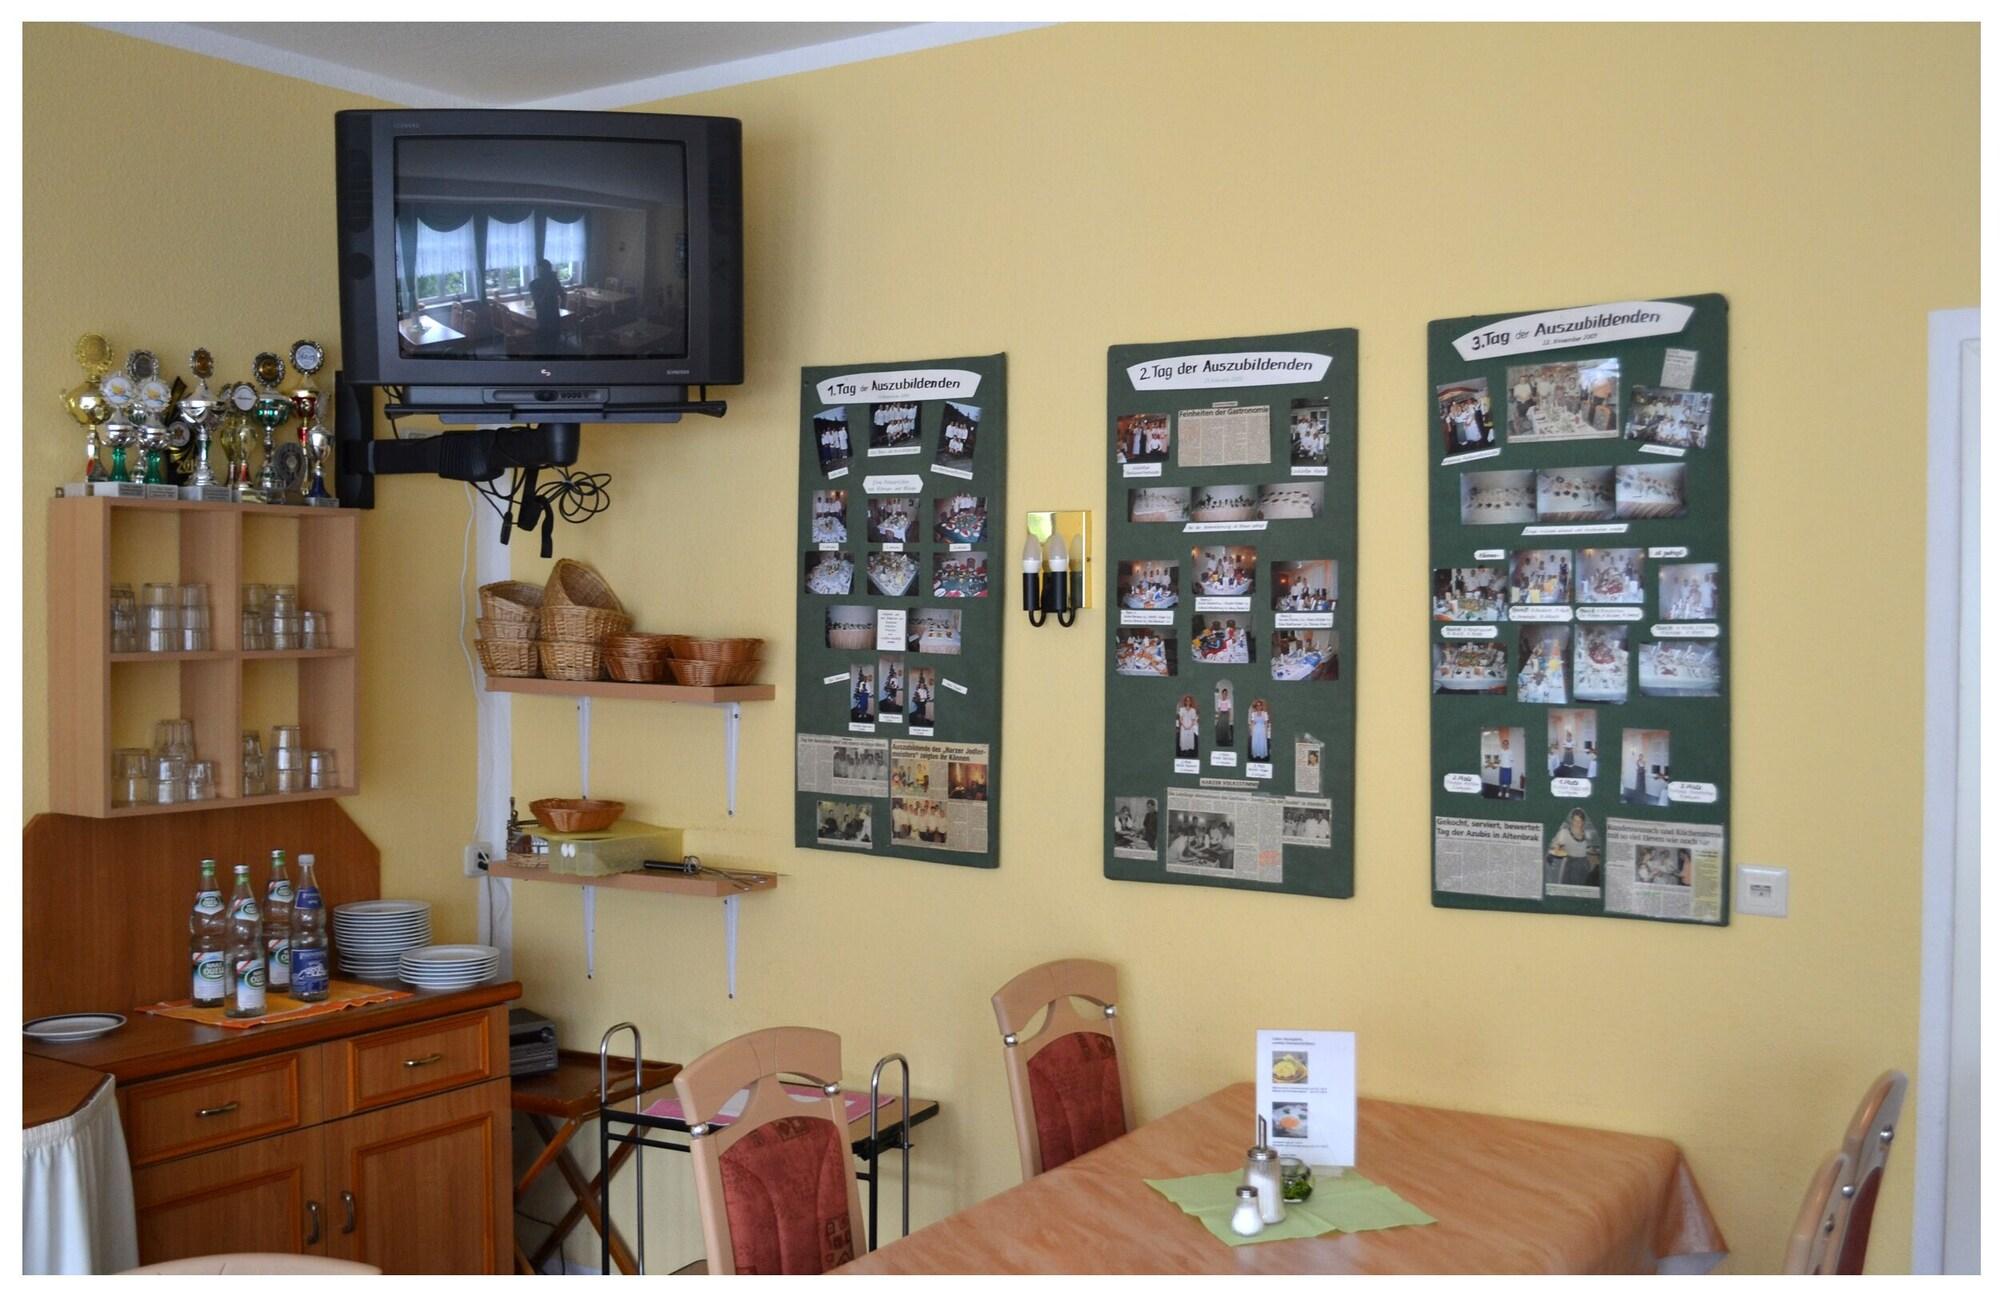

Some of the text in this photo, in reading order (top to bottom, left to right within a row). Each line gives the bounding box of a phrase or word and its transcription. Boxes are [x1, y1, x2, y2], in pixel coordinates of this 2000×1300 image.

[1515, 329, 1530, 341] der
[1534, 309, 1660, 337] Auszubildenden
[1177, 362, 1198, 375] der
[1202, 357, 1313, 373] Auszubildenden
[871, 377, 961, 391] Auszubildenden
[1215, 408, 1226, 416] der
[1437, 827, 1449, 837] Tag
[1452, 828, 1464, 836] der
[1467, 829, 1490, 838] Azubis
